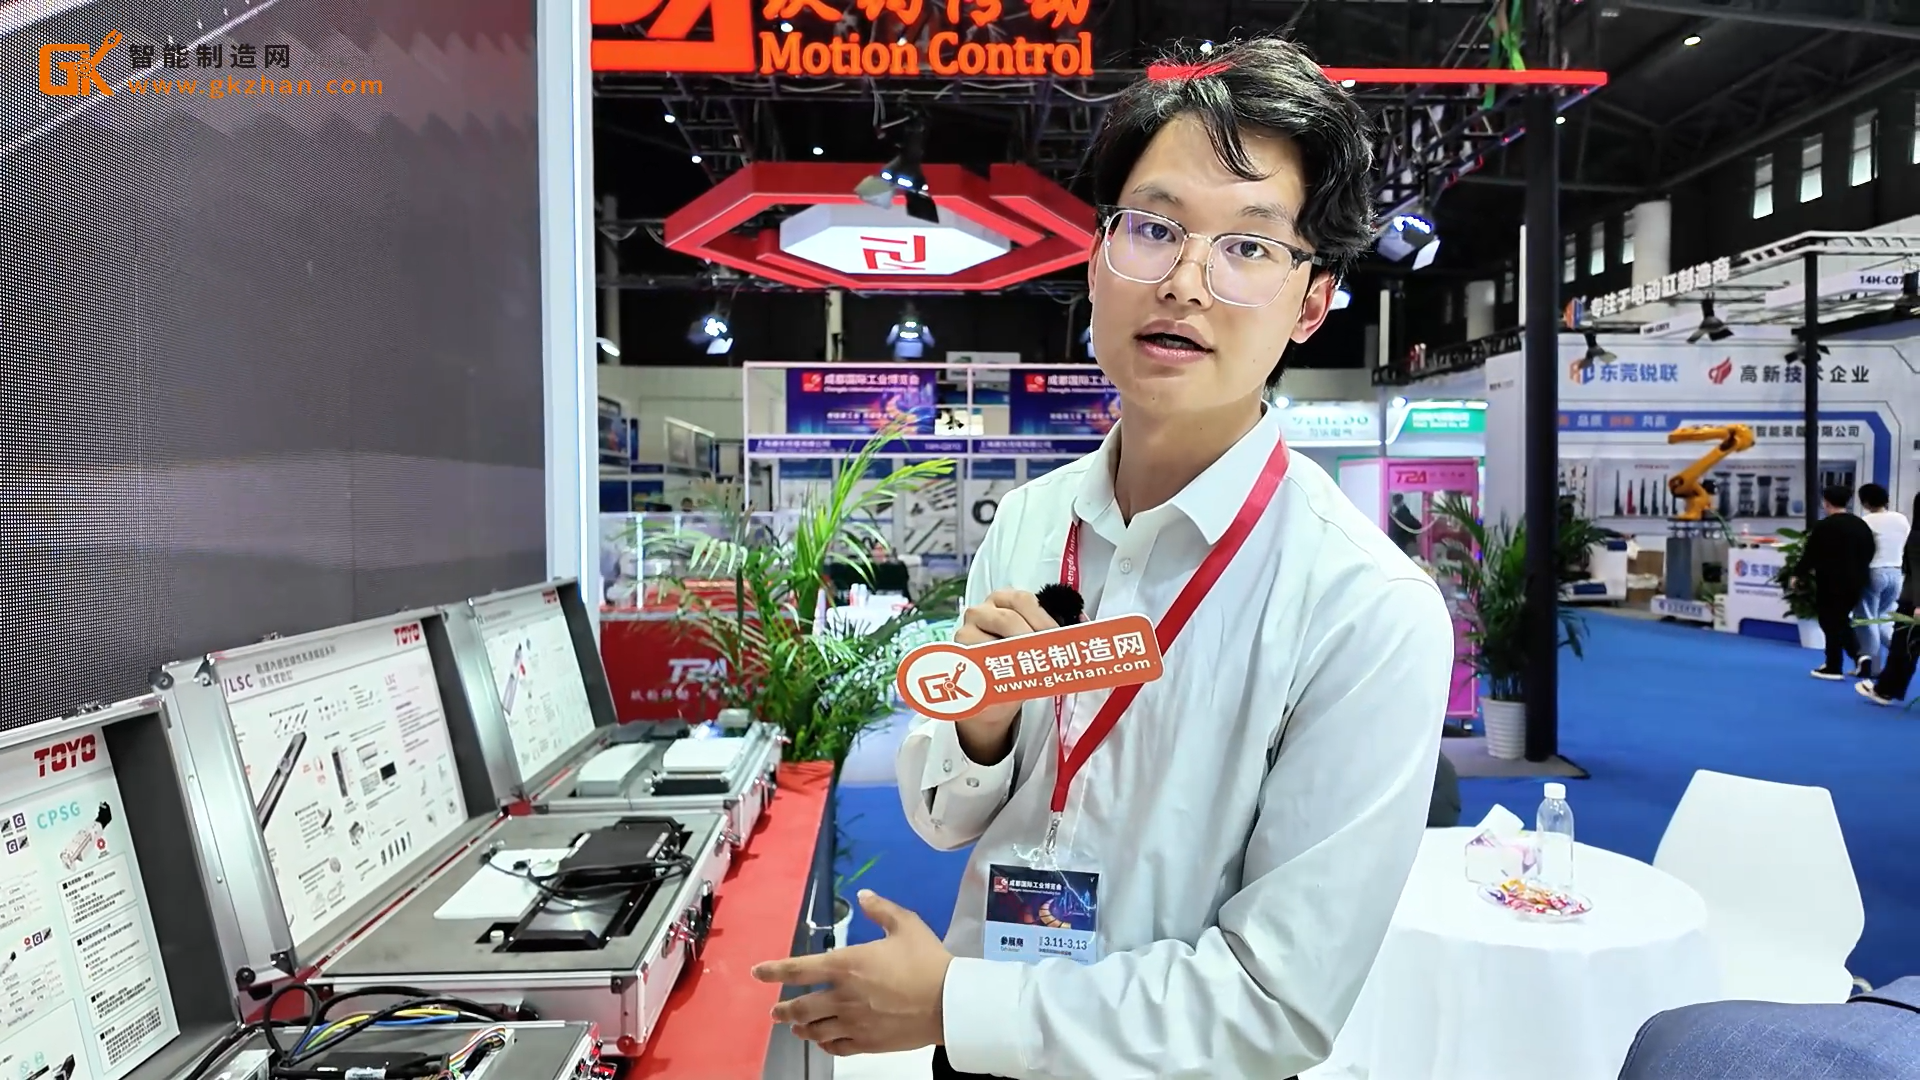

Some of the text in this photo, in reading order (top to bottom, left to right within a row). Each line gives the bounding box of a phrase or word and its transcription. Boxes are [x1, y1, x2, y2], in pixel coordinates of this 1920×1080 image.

[760, 32, 919, 75] Motion
[929, 31, 1093, 75] Control
[1590, 256, 1730, 317] 专注于电动缸制造商
[1600, 363, 1678, 382] 东莞锐联
[393, 623, 420, 646] TOYO
[985, 632, 1146, 681] 智能制造网
[993, 658, 1151, 694] www.gkzhan.com
[34, 734, 96, 778] TOYO
[37, 801, 81, 829] CPSG
[1044, 936, 1088, 951] 3.11-3.13
